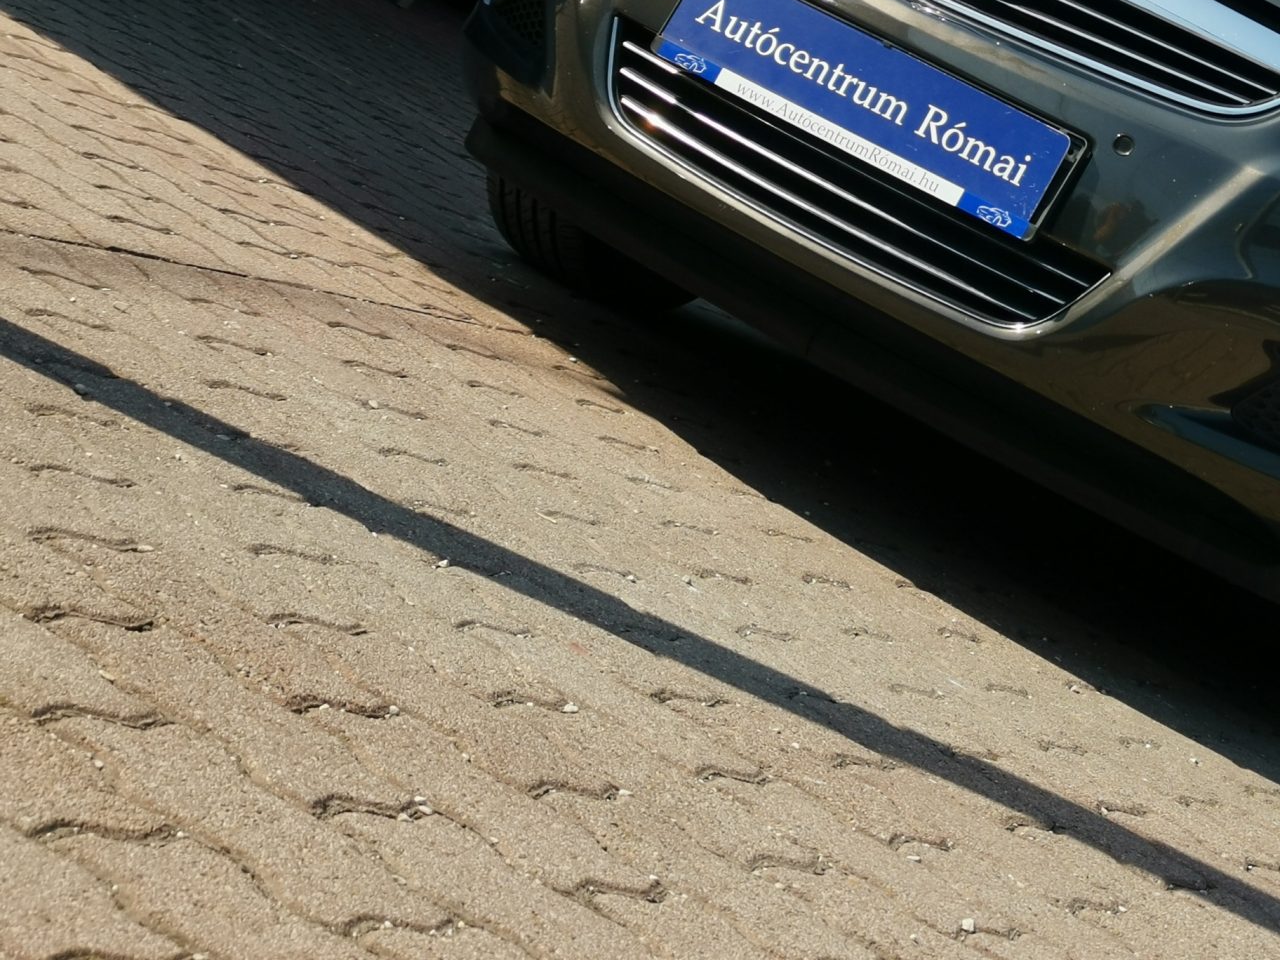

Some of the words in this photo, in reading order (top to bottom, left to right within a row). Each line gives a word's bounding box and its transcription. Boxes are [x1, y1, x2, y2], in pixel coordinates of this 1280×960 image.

[695, 0, 908, 126] Autócentrum
[914, 104, 1032, 187] Római
[736, 82, 940, 194] www.AutócentrumRómai.hu
